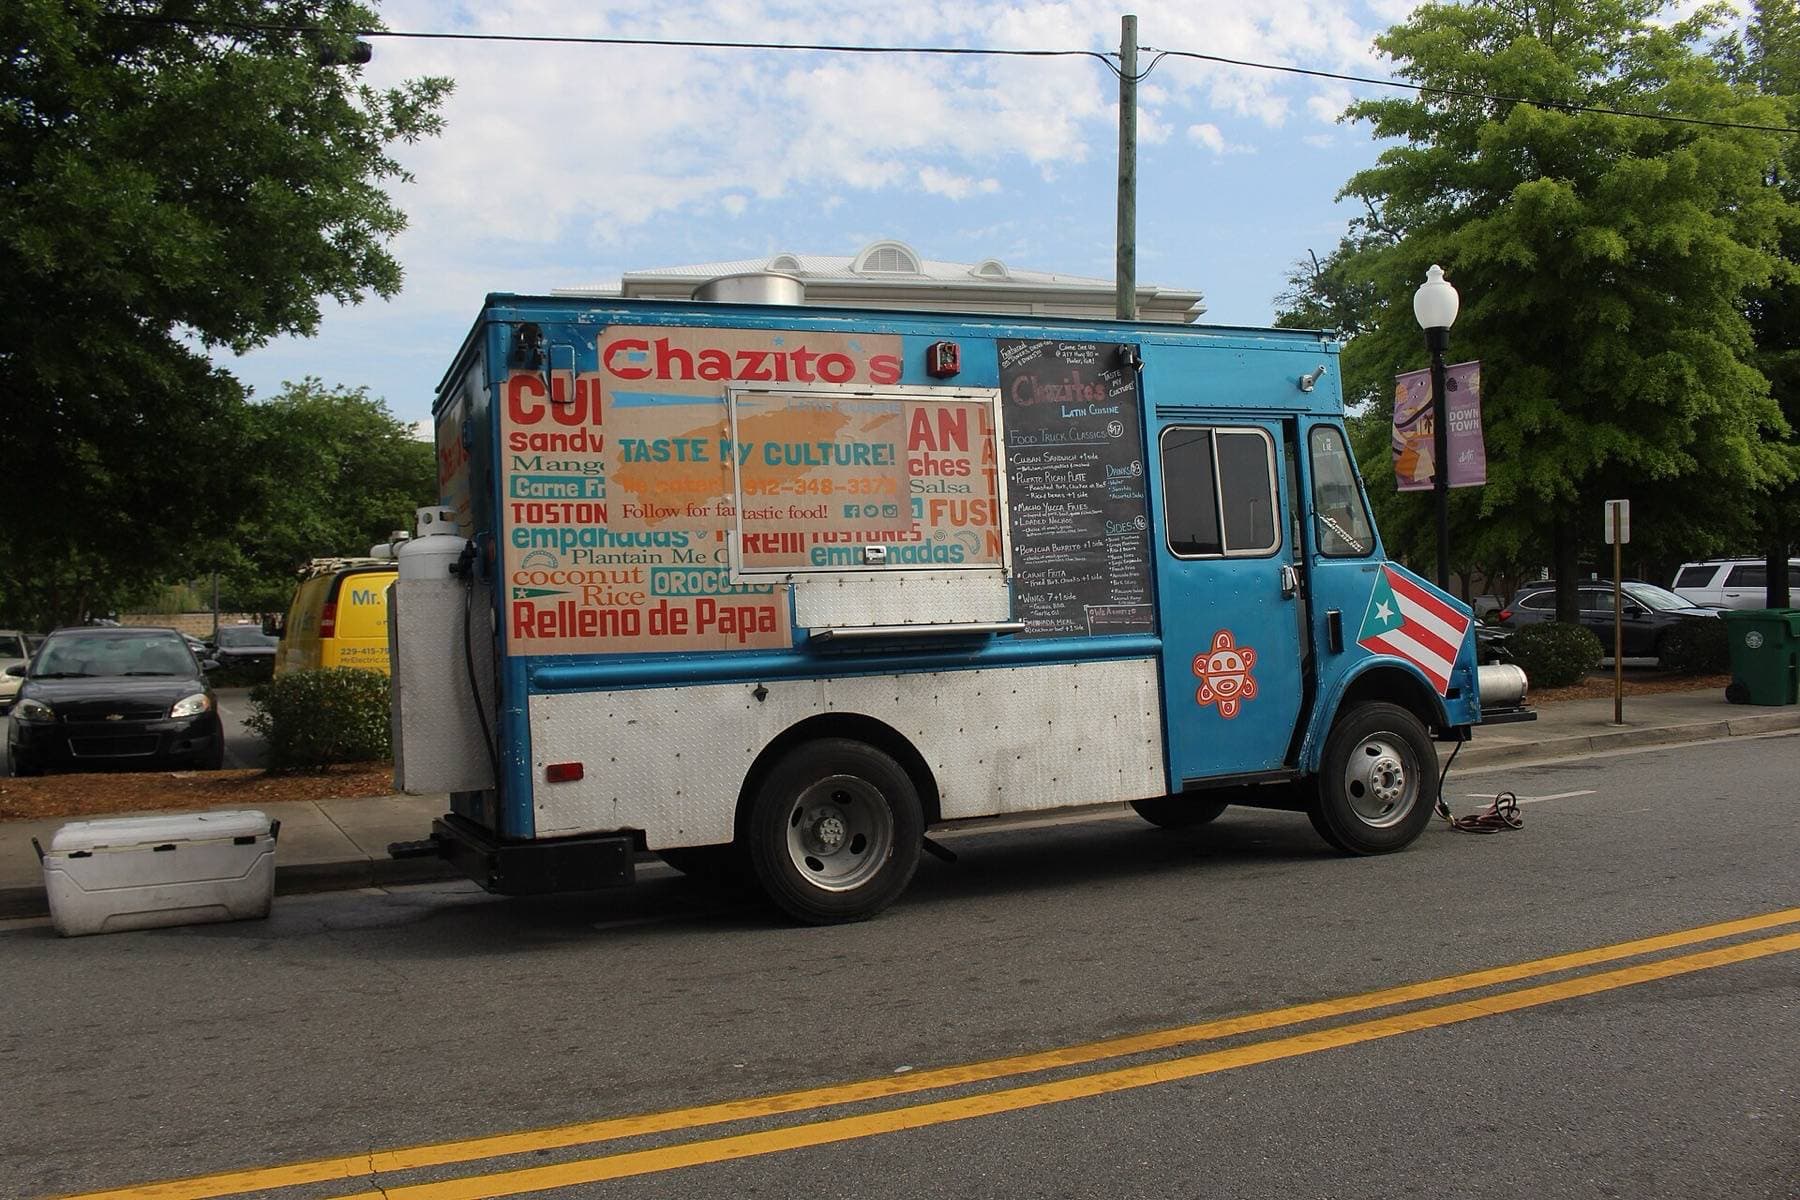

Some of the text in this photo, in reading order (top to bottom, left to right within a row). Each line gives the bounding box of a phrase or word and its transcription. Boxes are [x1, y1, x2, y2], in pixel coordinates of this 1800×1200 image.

[1449, 408, 1479, 422] DOWN
[1039, 428, 1066, 442] TRUCK
[1449, 419, 1480, 433] TOWN
[619, 439, 709, 463] TASTE
[764, 440, 896, 467] CULTURE!
[511, 455, 604, 476] Mang
[908, 452, 971, 477] ches
[516, 478, 578, 498] Carne
[909, 479, 972, 494] Salsa
[623, 503, 680, 519] Follow
[686, 503, 711, 517] for
[788, 504, 828, 520] food!
[571, 549, 663, 565] Plantain
[811, 538, 964, 567] empnadas
[512, 567, 646, 586] coconut
[352, 590, 380, 606] Mr.
[580, 585, 645, 606] Rice
[512, 598, 777, 644] Relleno de Papa
